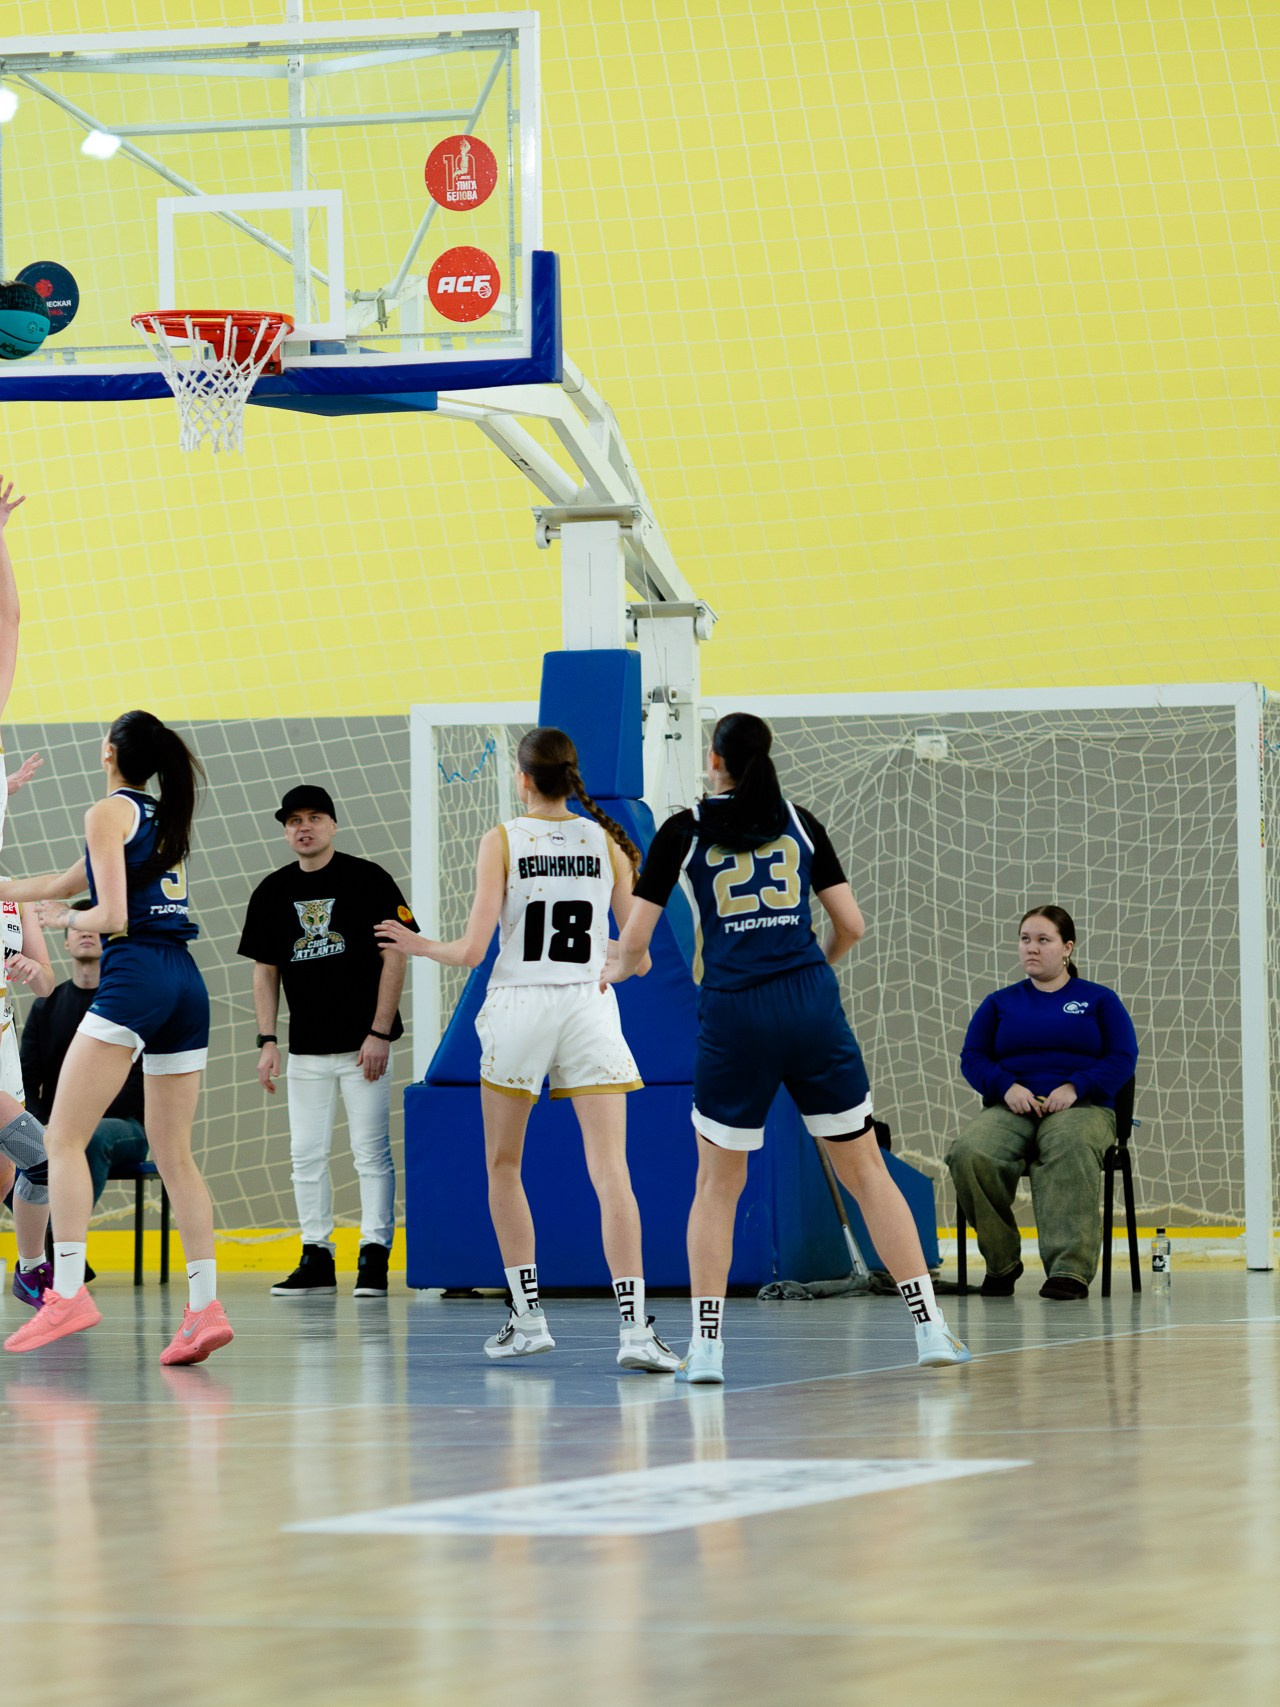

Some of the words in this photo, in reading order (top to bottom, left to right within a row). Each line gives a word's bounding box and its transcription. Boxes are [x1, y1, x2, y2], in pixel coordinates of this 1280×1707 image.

[446, 190, 478, 202] БЕЛОВА
[456, 180, 477, 191] ЛИГА
[436, 275, 492, 298] АСБ
[518, 854, 602, 880] ВЕШНЯКОВА
[705, 834, 801, 918] 23
[522, 900, 593, 964] 18
[724, 915, 801, 934] ГЦОЛИФК
[296, 942, 343, 959] ATLANTA
